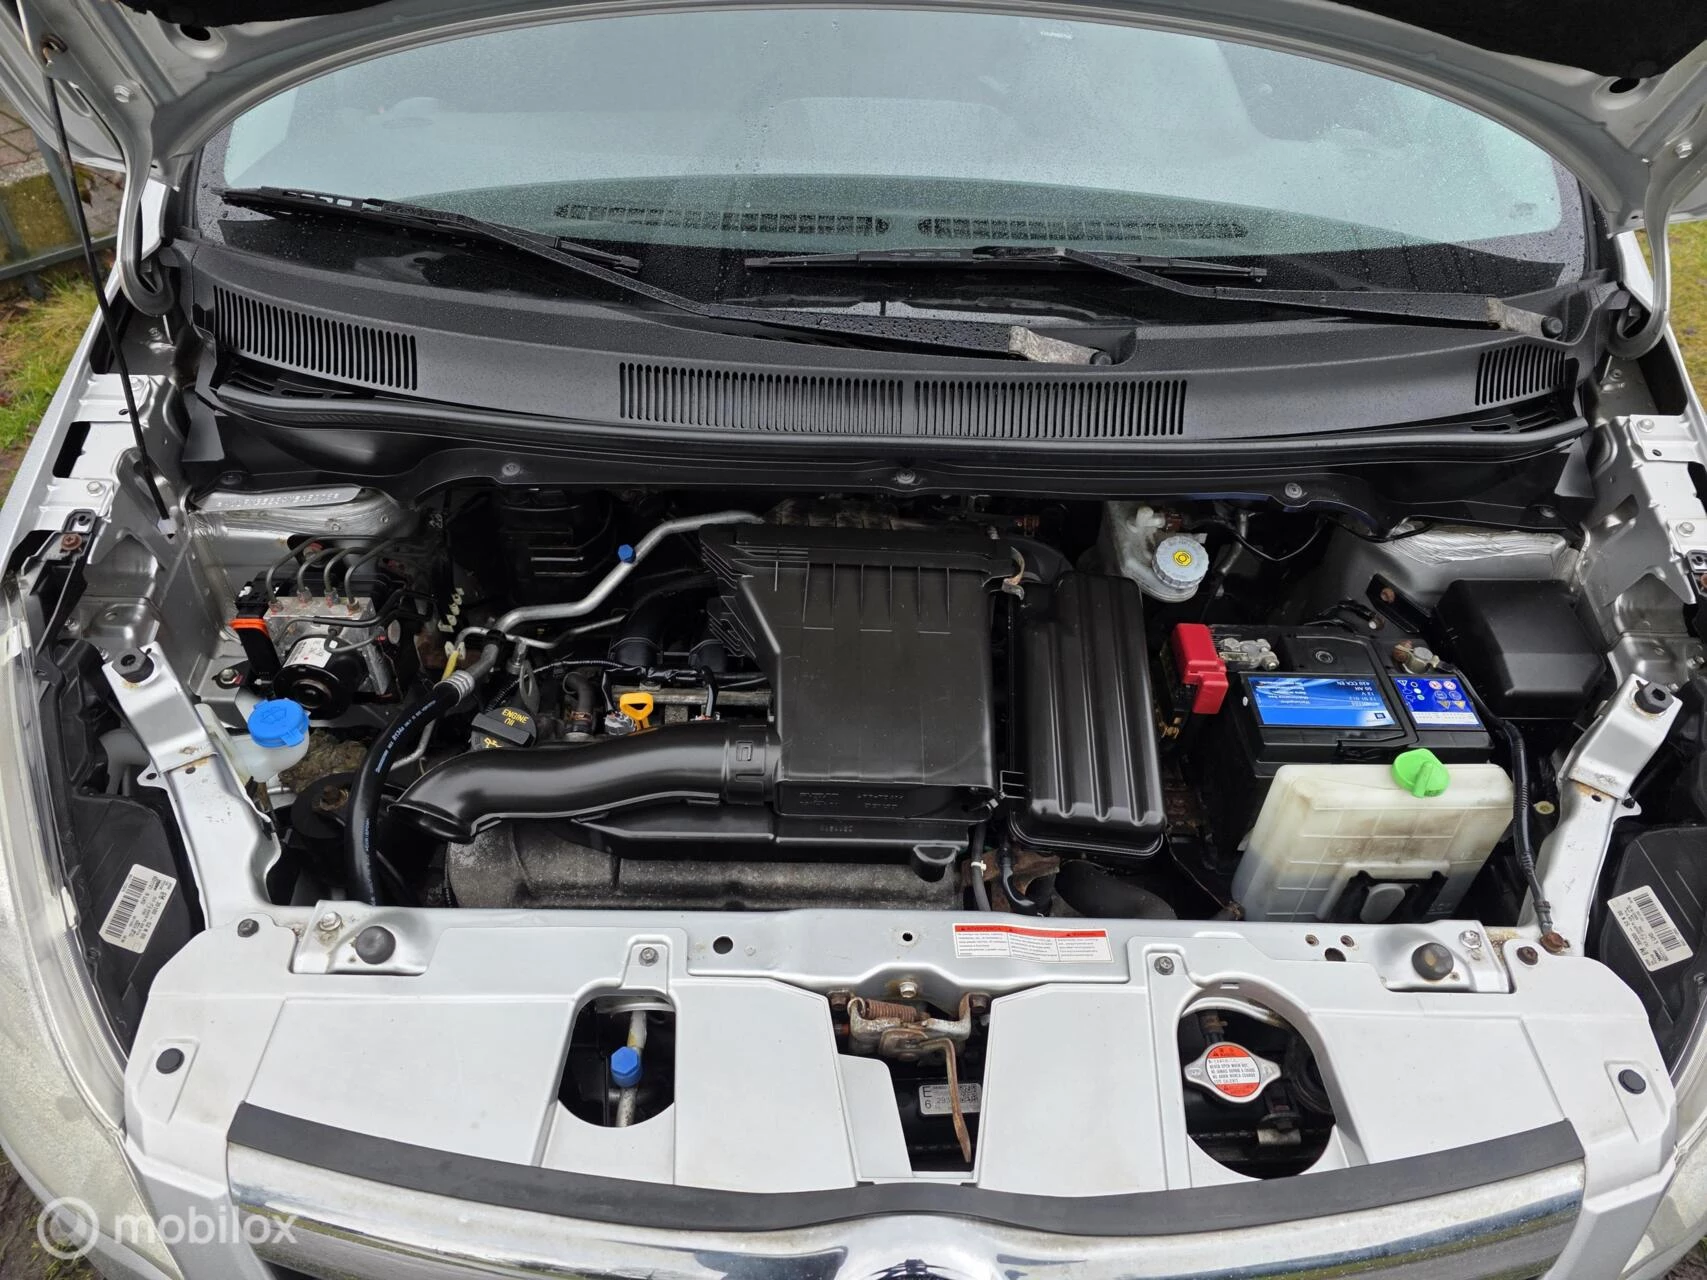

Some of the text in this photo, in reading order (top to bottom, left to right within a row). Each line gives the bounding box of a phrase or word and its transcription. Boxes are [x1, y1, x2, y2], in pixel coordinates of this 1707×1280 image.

[502, 708, 529, 724] ENGINE
[923, 1086, 932, 1098] E
[925, 1099, 932, 1109] 6
